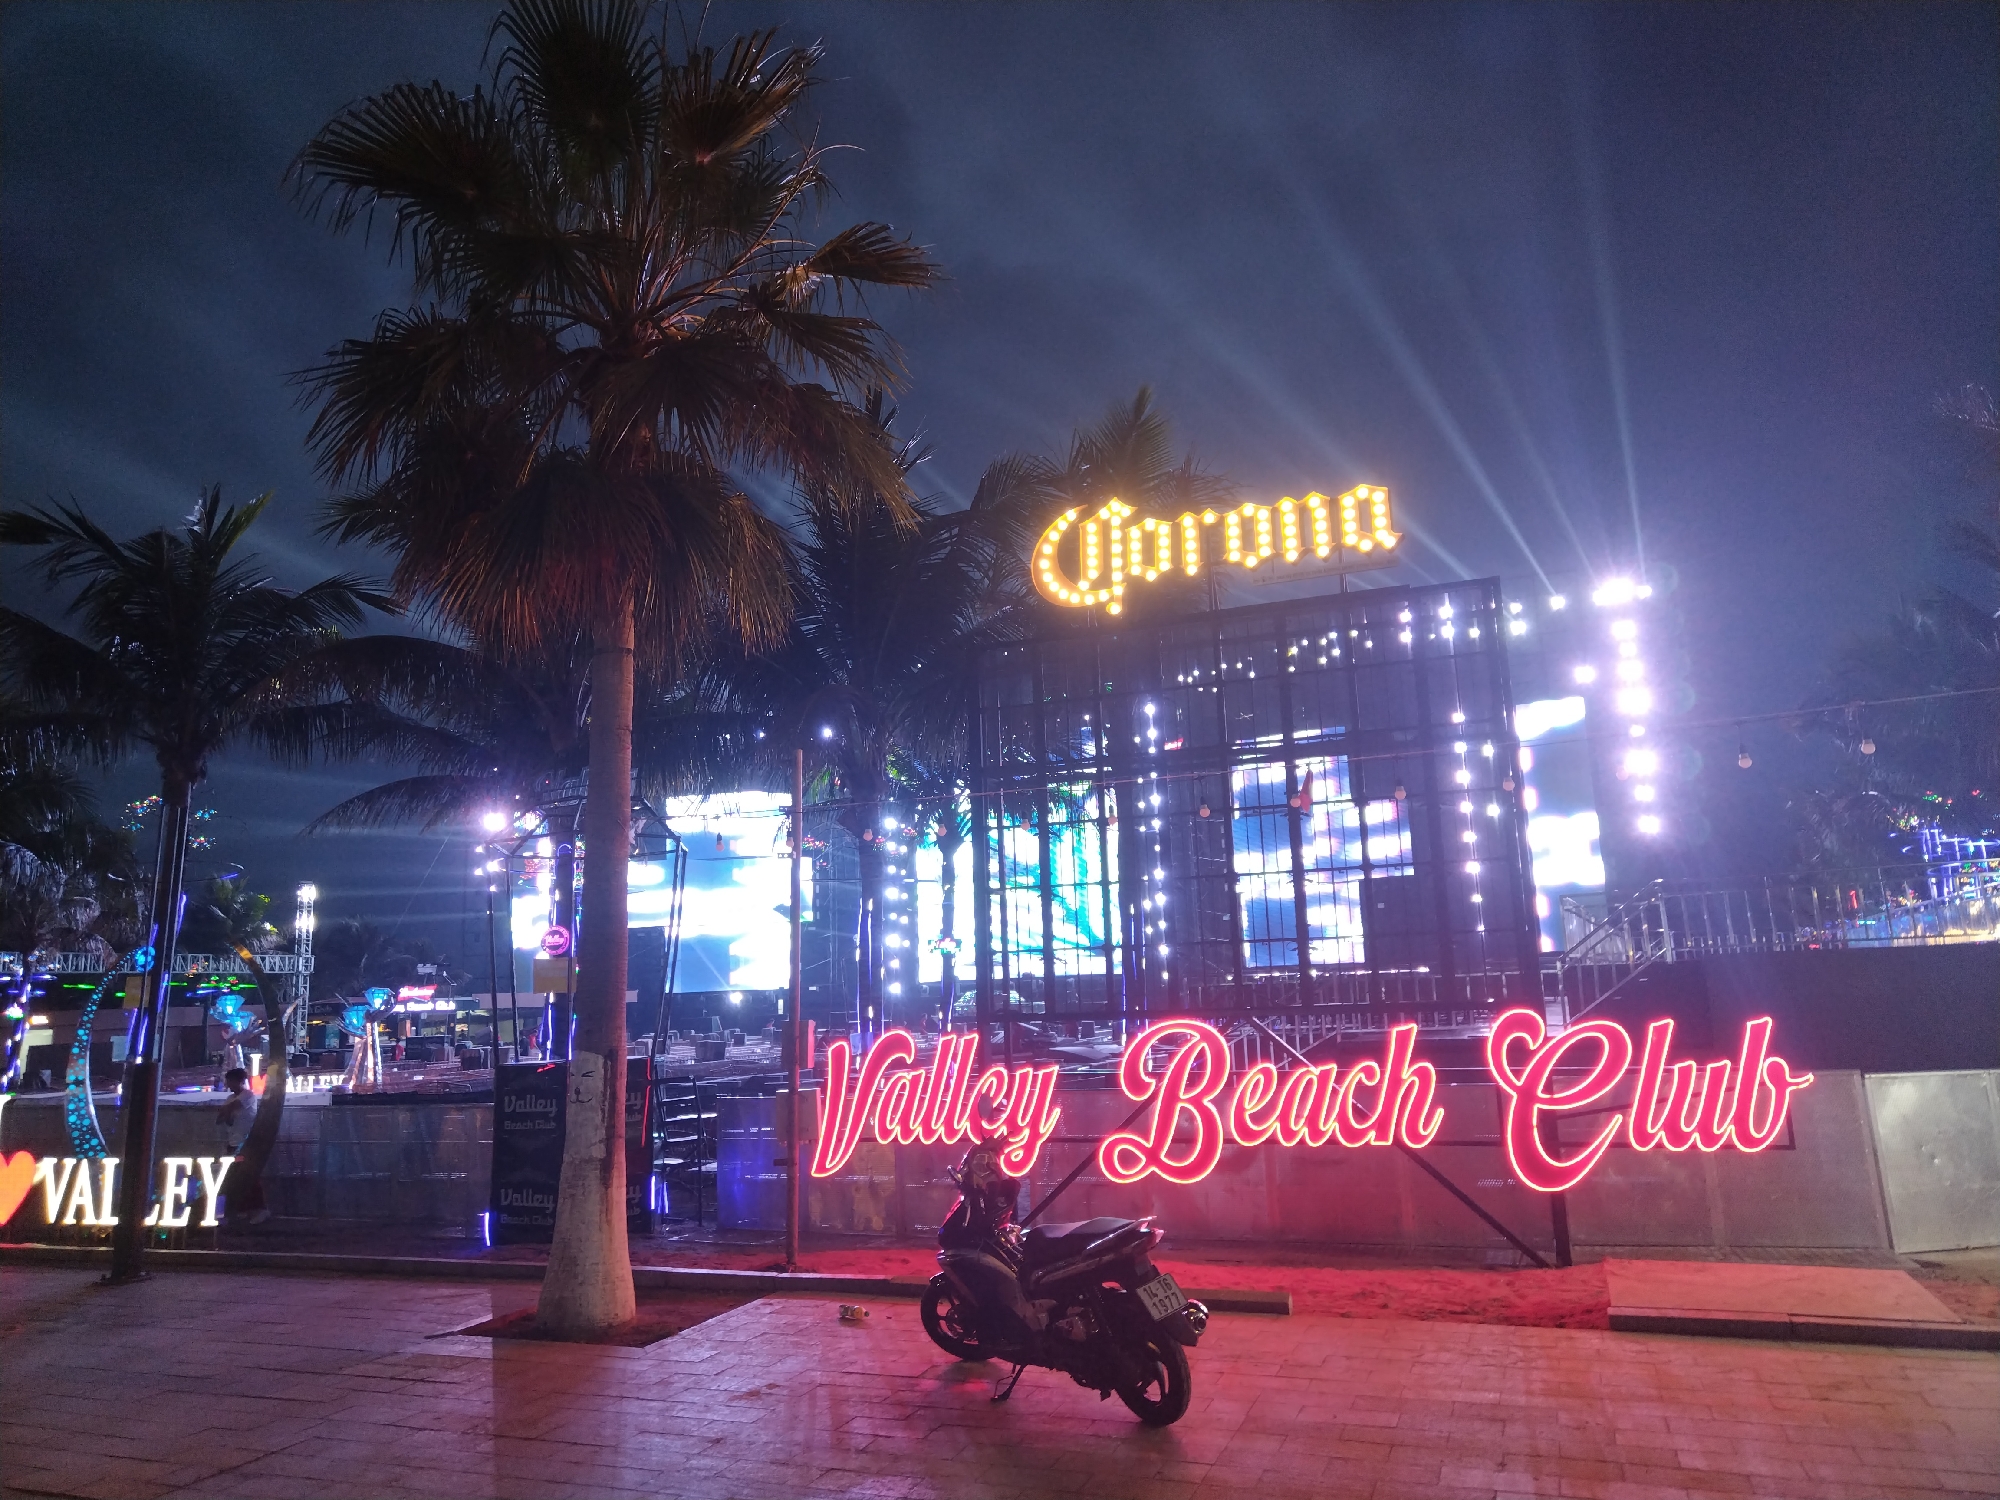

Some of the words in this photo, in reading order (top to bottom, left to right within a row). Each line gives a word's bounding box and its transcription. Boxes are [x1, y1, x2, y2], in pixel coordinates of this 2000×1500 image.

[1031, 484, 1403, 615] Corona
[503, 1094, 558, 1118] Valley
[811, 1029, 1061, 1178] Valley
[1099, 1017, 1446, 1185] Beach
[1487, 1008, 1815, 1192] Club
[504, 1119, 534, 1131] Beach
[500, 1188, 555, 1214] Valley
[1142, 1277, 1174, 1301] 14-T6
[1151, 1292, 1183, 1316] 1977
